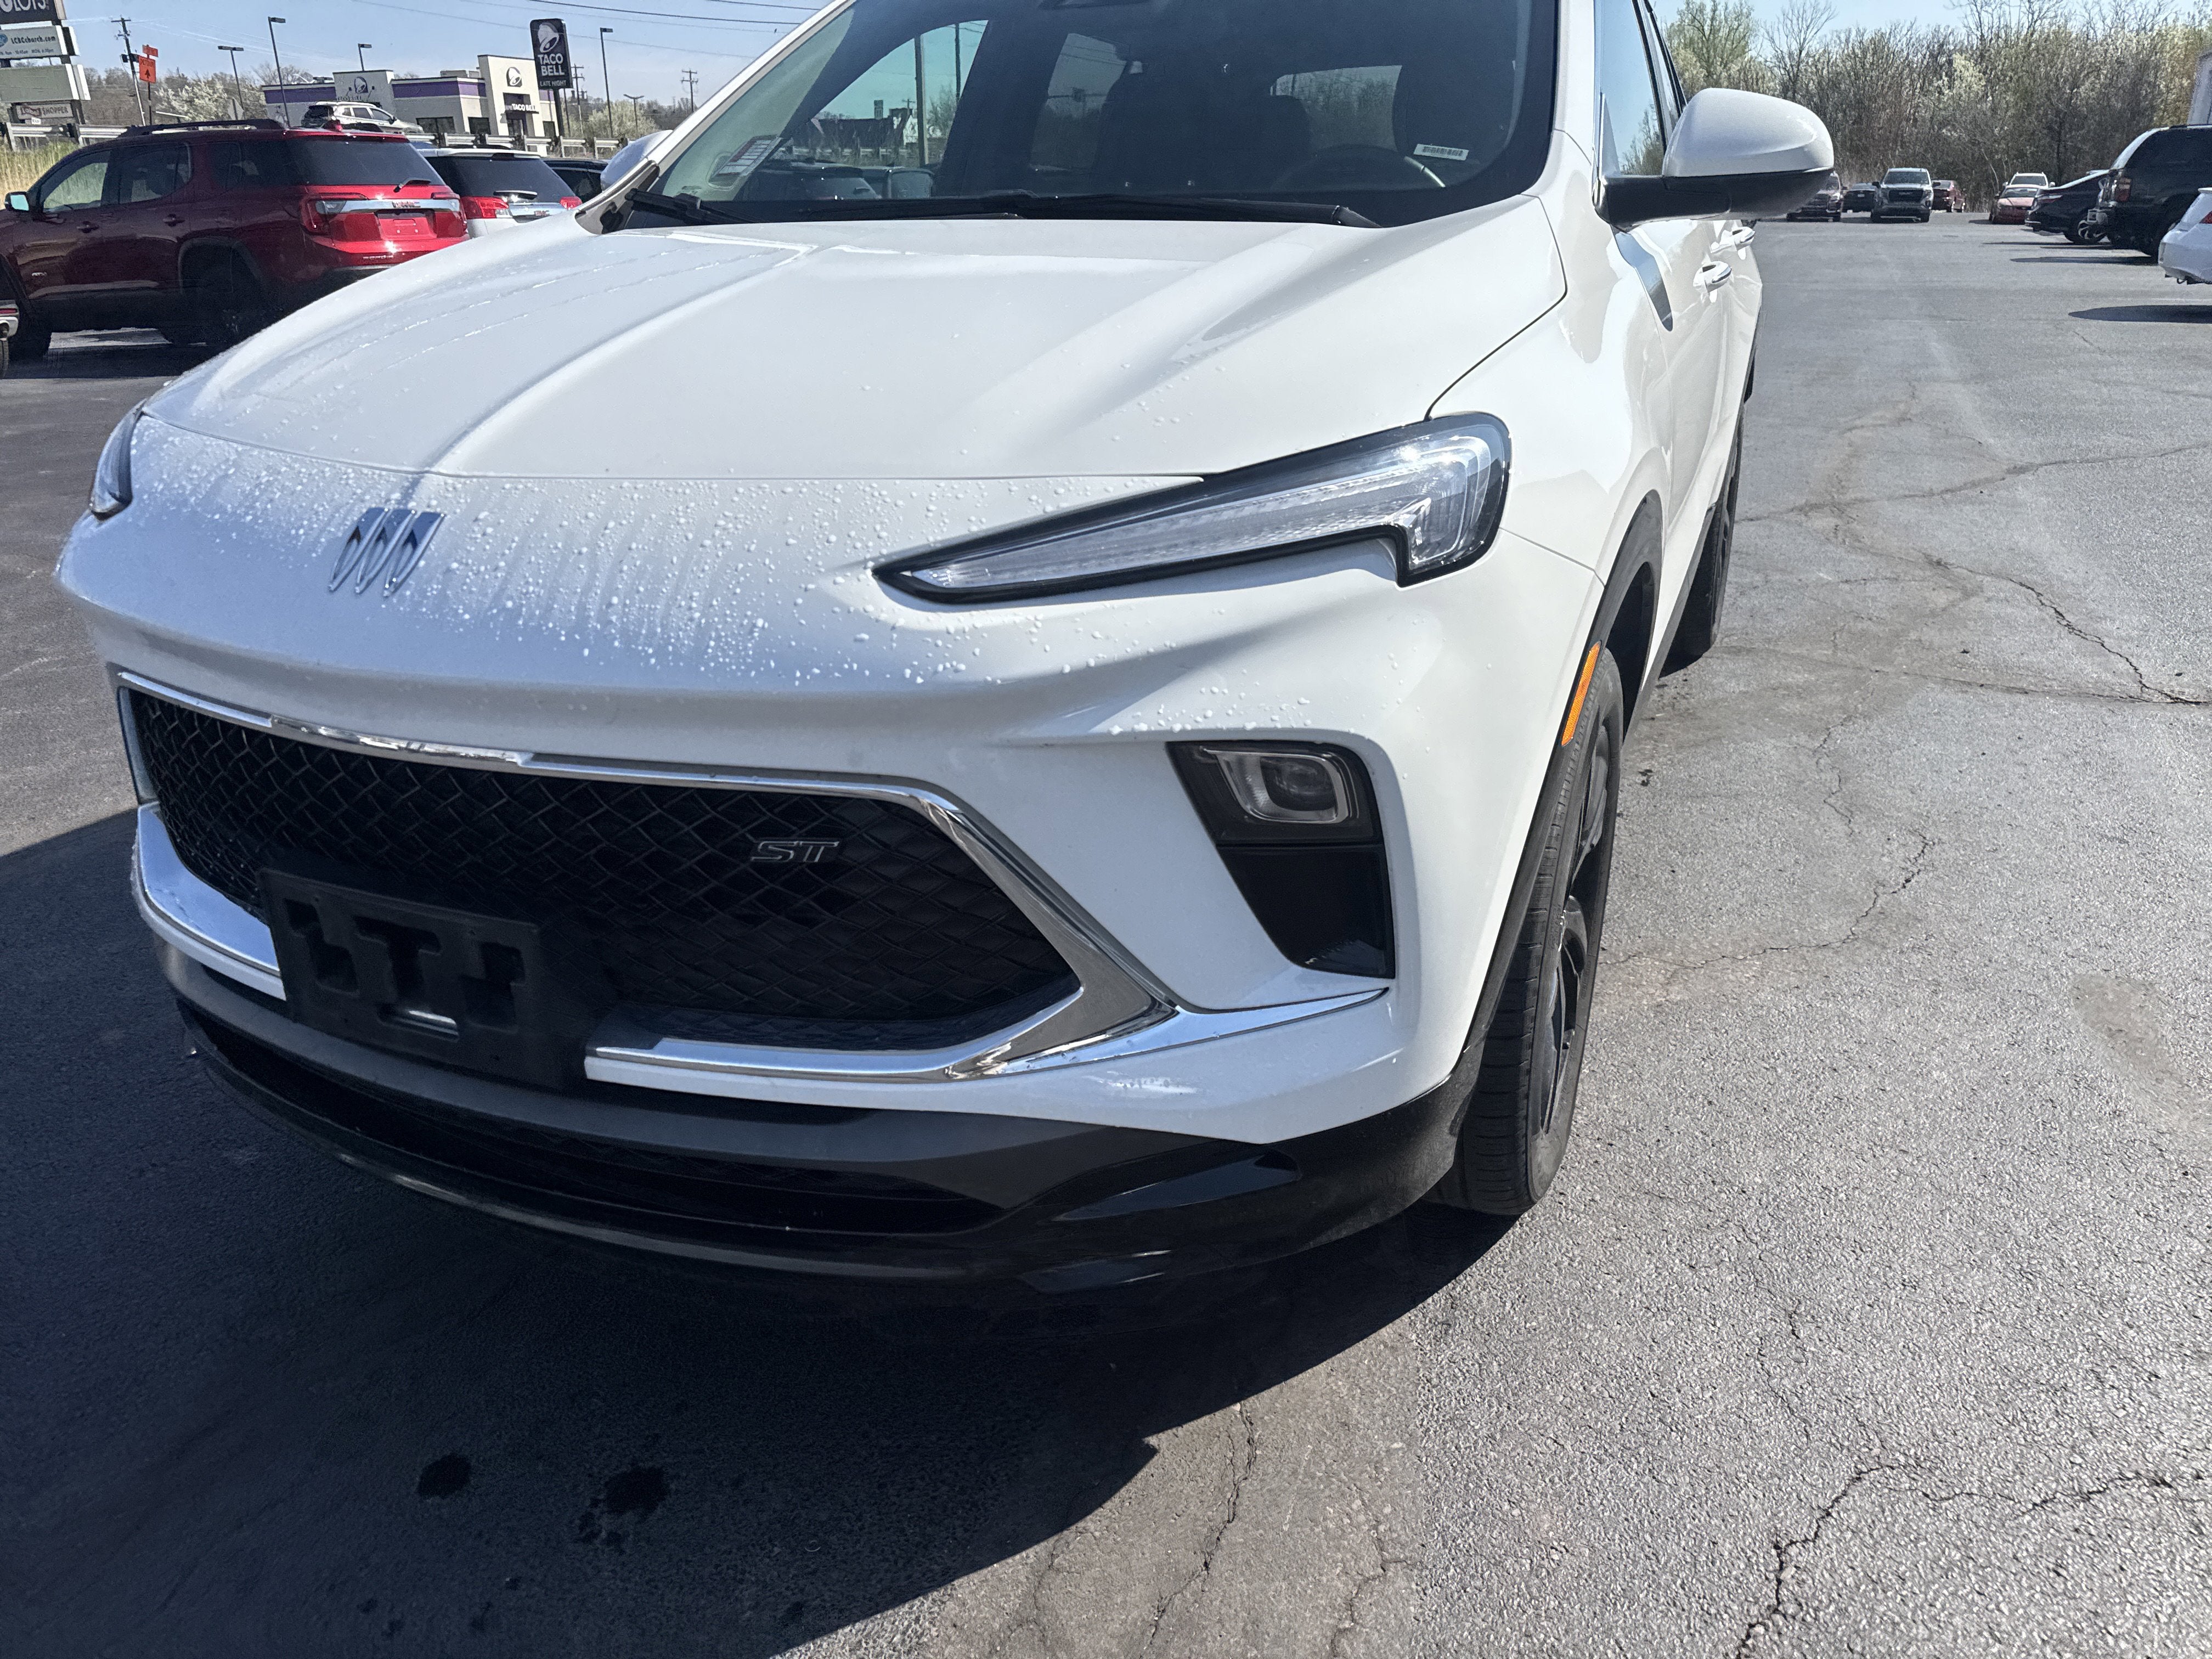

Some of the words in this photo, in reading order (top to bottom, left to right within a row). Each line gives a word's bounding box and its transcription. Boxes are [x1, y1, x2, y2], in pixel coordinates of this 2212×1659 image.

[538, 53, 563, 65] TACO
[540, 65, 565, 76] BELL
[750, 840, 839, 862] ST
